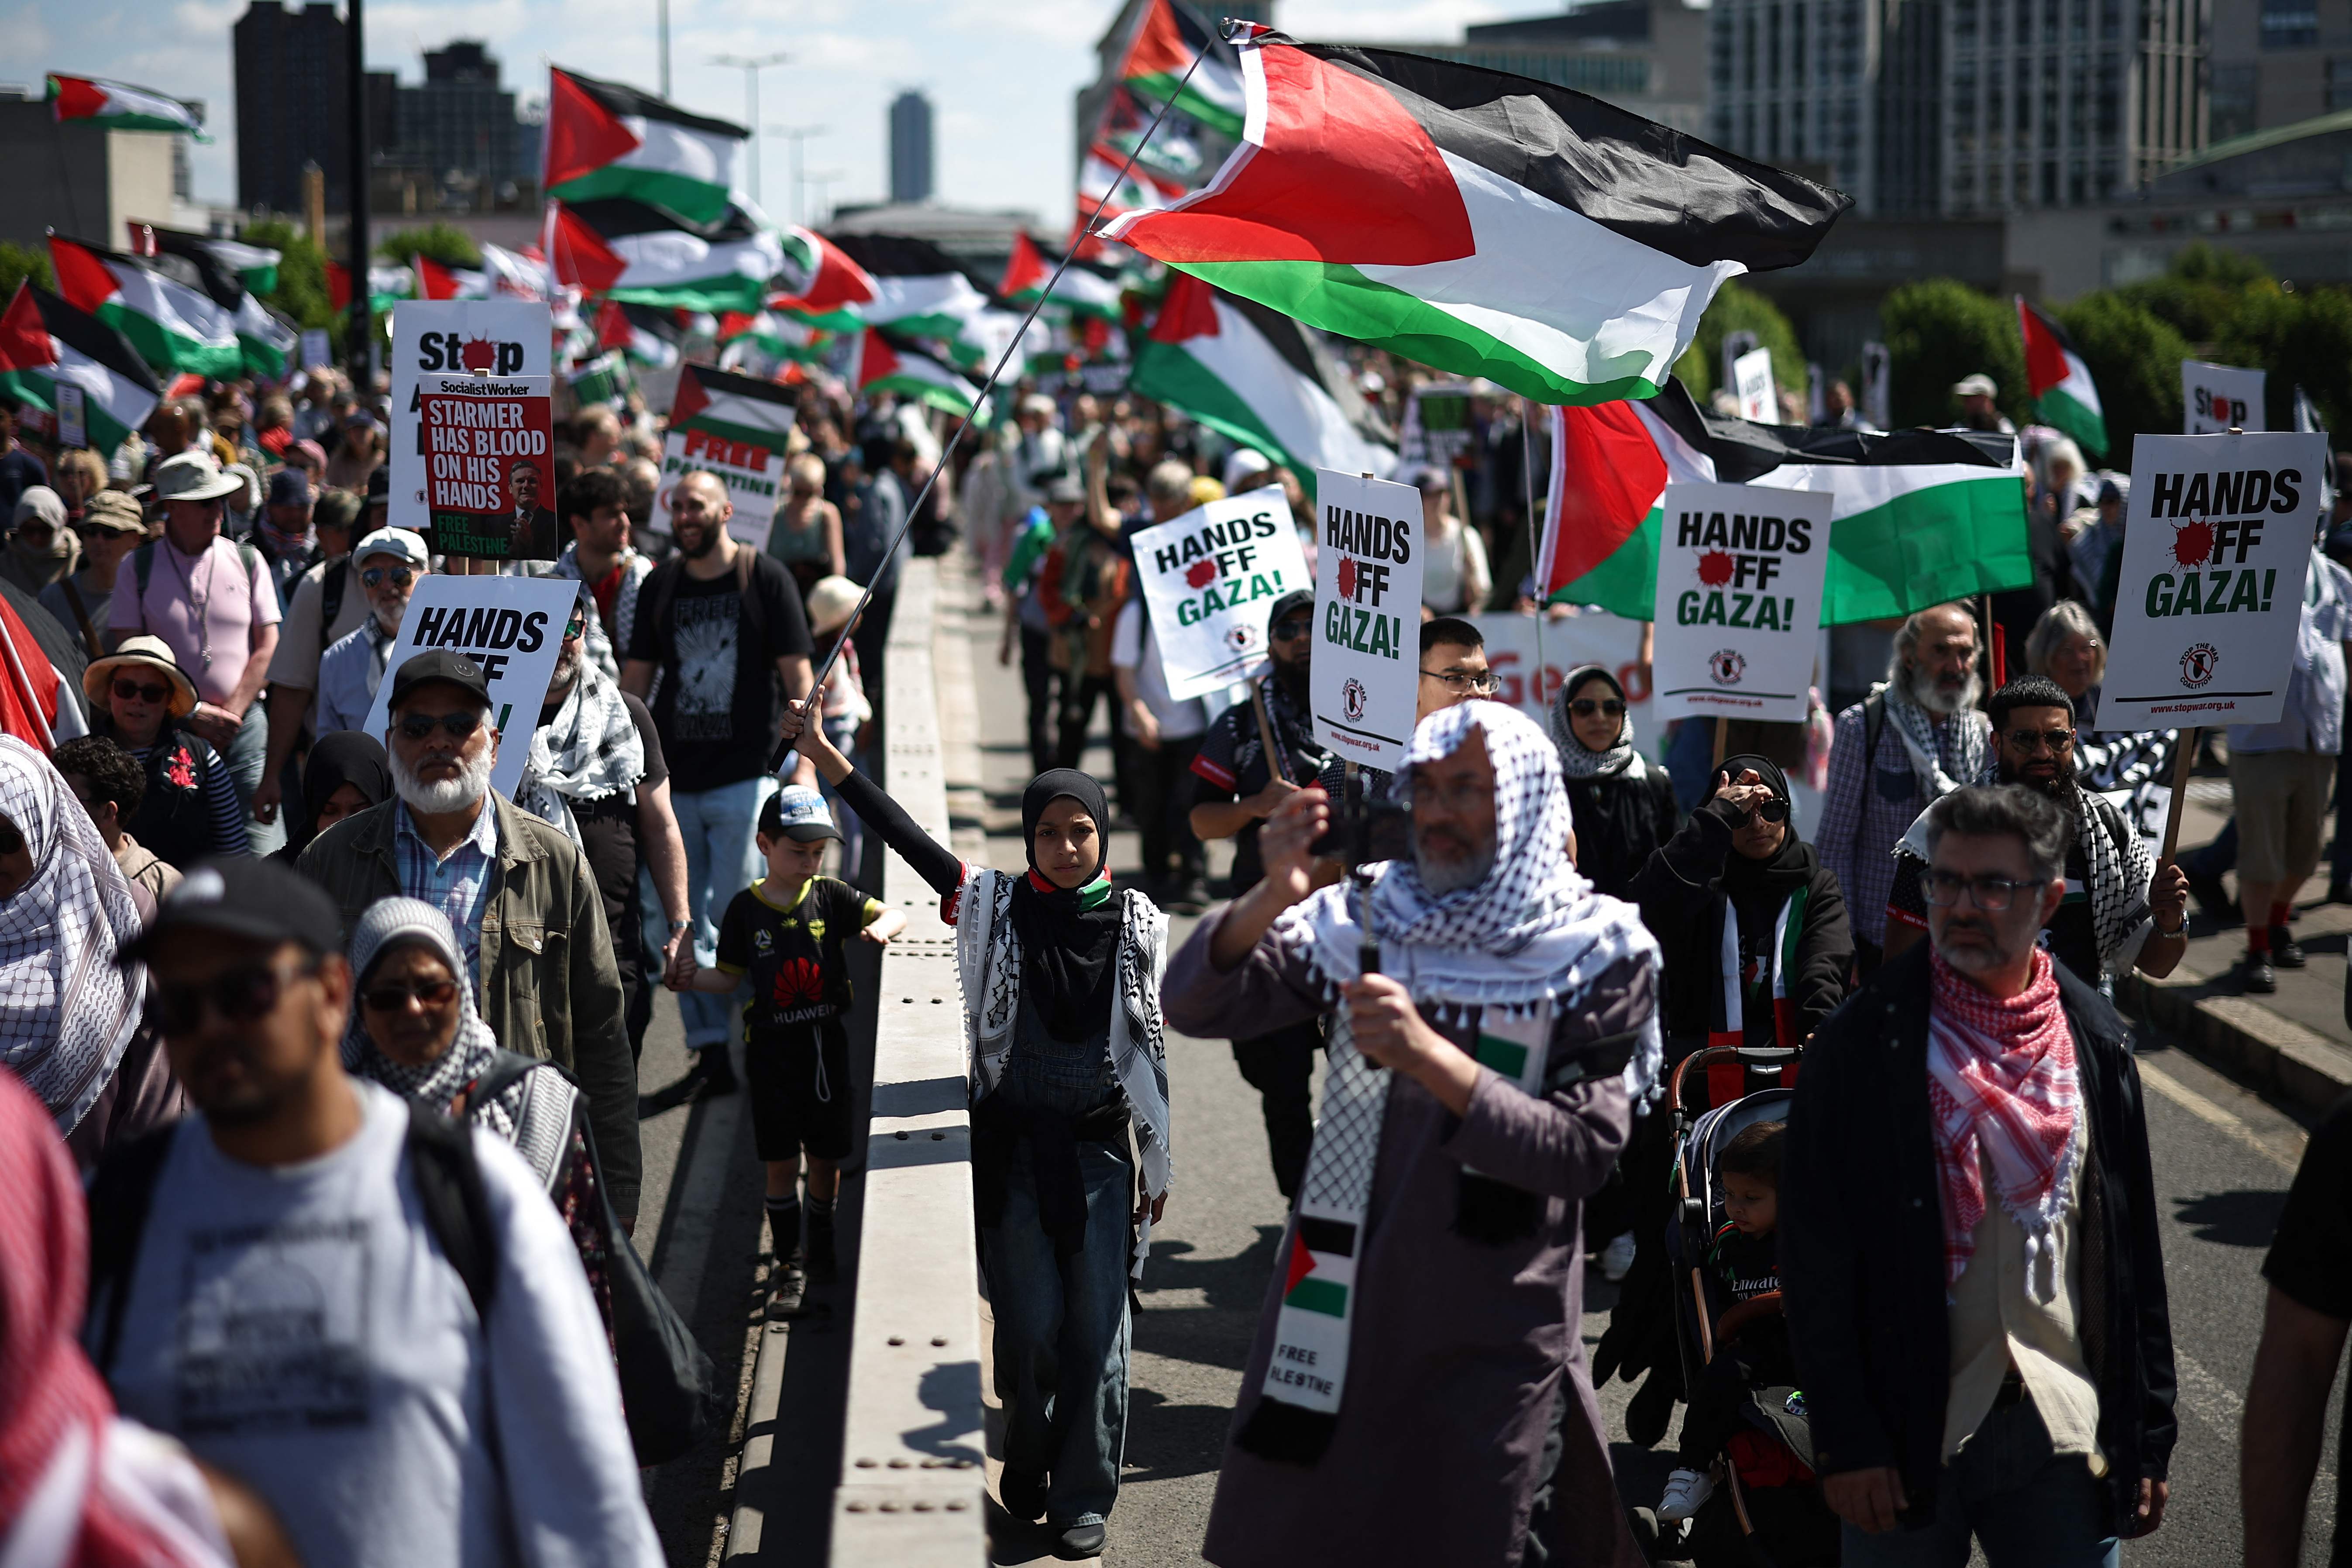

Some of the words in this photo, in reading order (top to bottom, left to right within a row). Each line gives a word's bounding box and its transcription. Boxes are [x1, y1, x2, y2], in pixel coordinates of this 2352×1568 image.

[429, 399, 524, 428] STARMER
[431, 426, 469, 454] HAS
[475, 430, 546, 456] BLOOD
[685, 428, 771, 471] FREE
[433, 454, 461, 480] ON
[467, 457, 501, 483] HIS
[435, 481, 501, 510] HANDS
[2151, 468, 2302, 518] HANDS
[437, 515, 469, 533] FREE
[1327, 505, 1410, 564] HANDS
[1678, 512, 1812, 554] HANDS
[439, 533, 509, 554] PALESTINE
[1155, 512, 1276, 574] HANDS
[1177, 570, 1285, 626] GAZA!
[2146, 569, 2276, 618] GAZA!
[1677, 590, 1794, 631] GAZA!
[412, 607, 548, 653] HANDS
[1326, 601, 1400, 660] GAZA!
[2179, 646, 2194, 666] STOP
[2210, 646, 2219, 663] WAR
[2180, 674, 2213, 689] COALITION
[2151, 701, 2235, 713] www.stopwar.org.uk
[1331, 731, 1380, 751] www.stopwar.org.uk
[774, 1004, 830, 1023] HUAWEI
[1278, 1344, 1317, 1365] FREE
